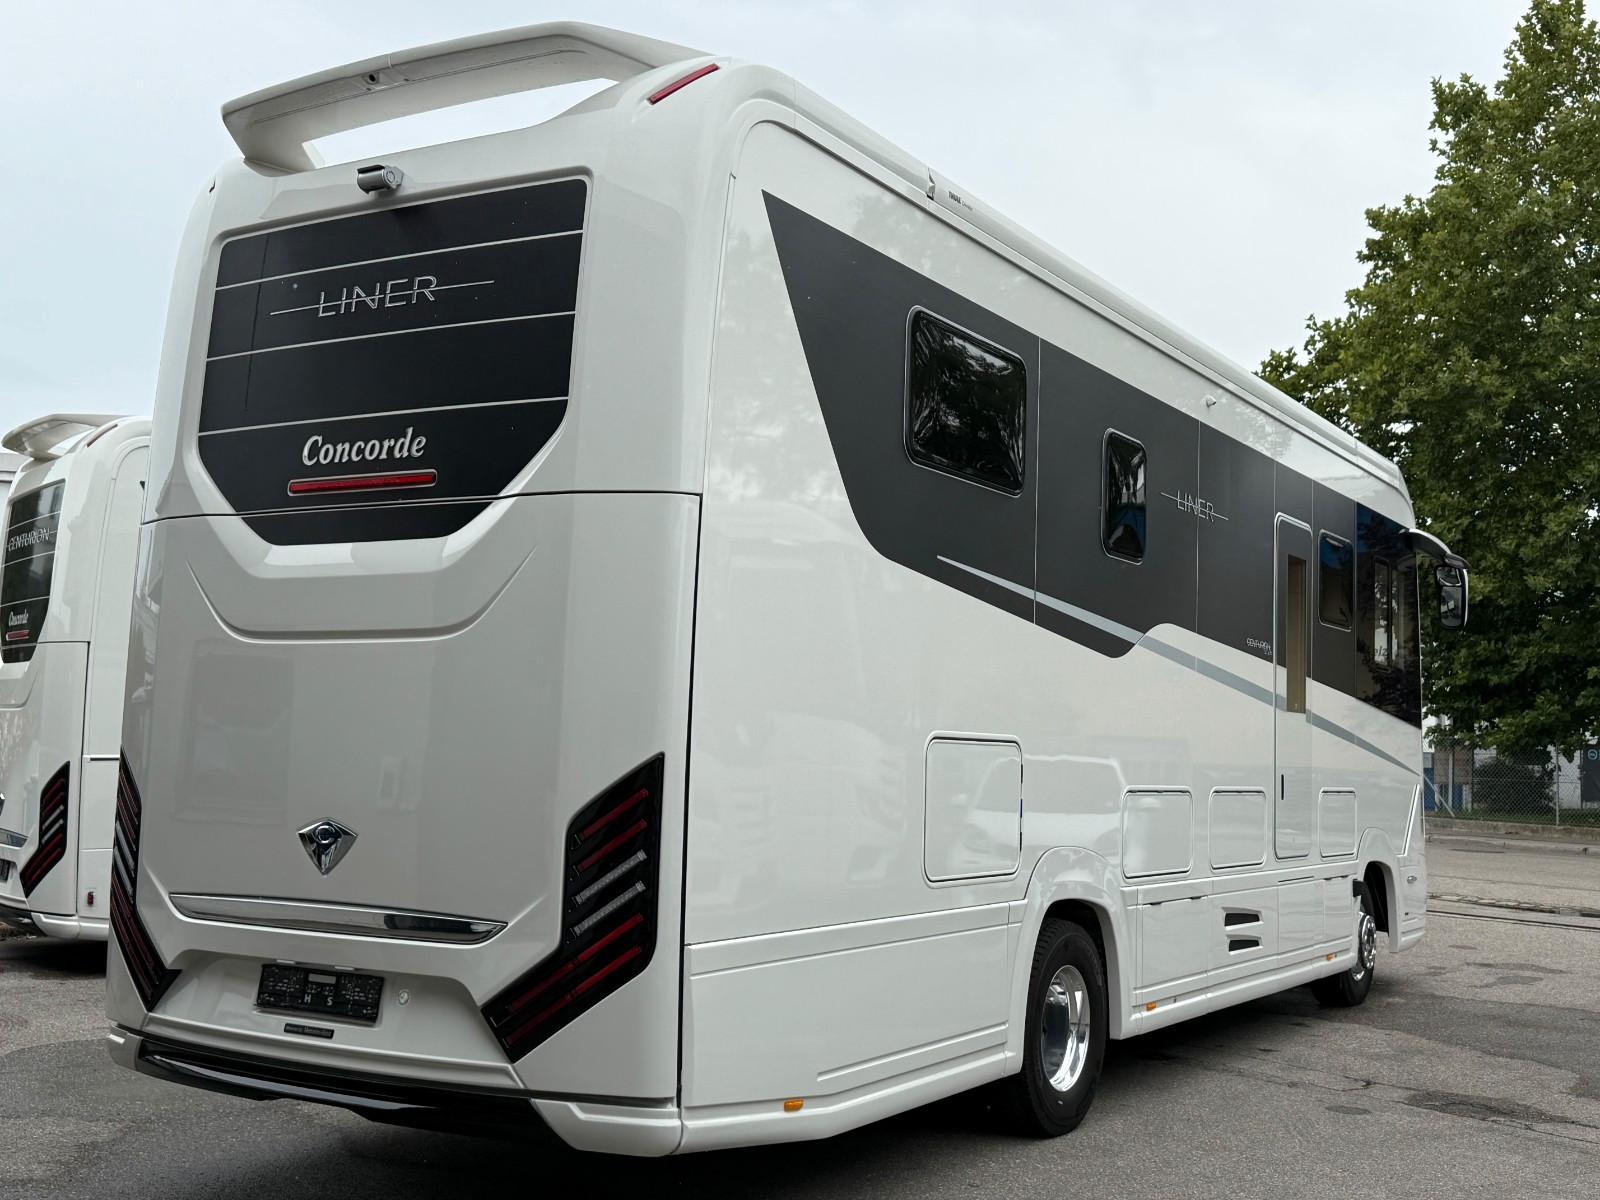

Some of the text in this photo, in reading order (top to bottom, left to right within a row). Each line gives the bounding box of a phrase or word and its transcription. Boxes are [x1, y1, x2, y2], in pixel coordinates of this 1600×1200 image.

[318, 275, 438, 318] LINER
[302, 426, 427, 466] Concorde
[1176, 489, 1214, 523] LINER
[8, 527, 50, 552] CENTURION
